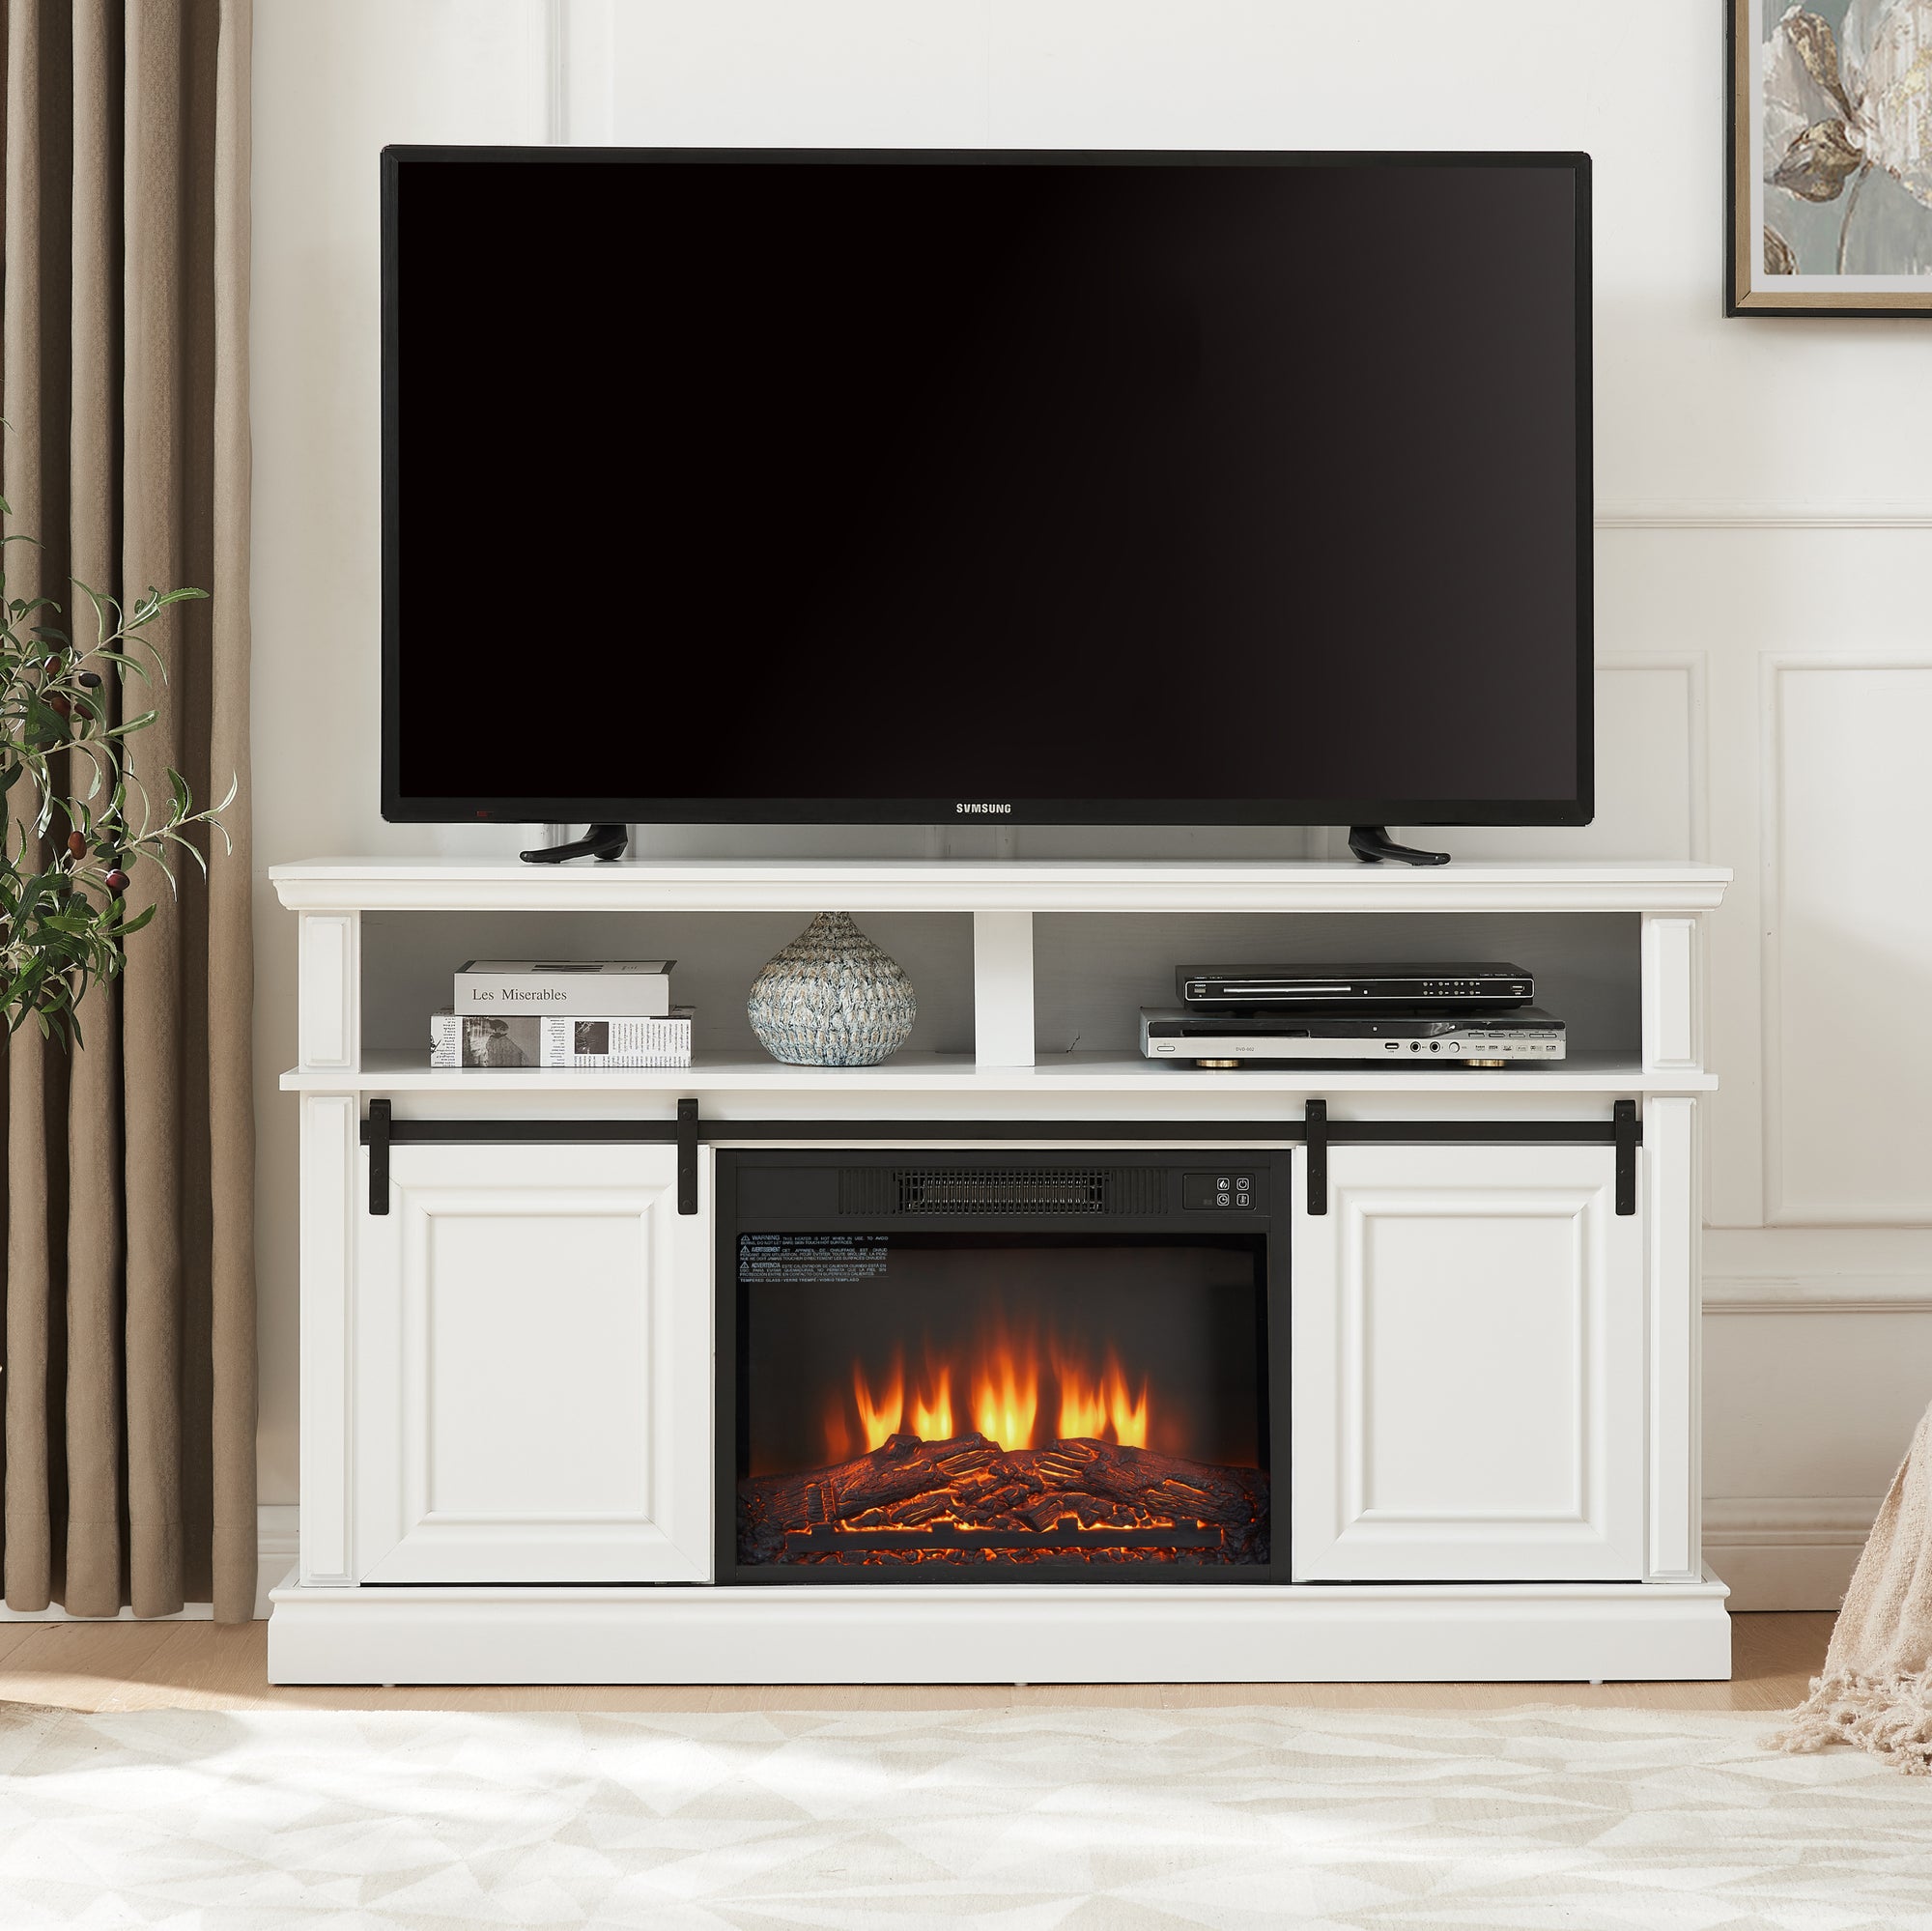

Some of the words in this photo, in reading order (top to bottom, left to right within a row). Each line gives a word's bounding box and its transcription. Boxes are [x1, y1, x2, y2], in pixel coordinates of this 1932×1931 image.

[956, 803, 1011, 813] SVMSUNG
[472, 988, 495, 1001] Les
[501, 988, 567, 1001] Miserables
